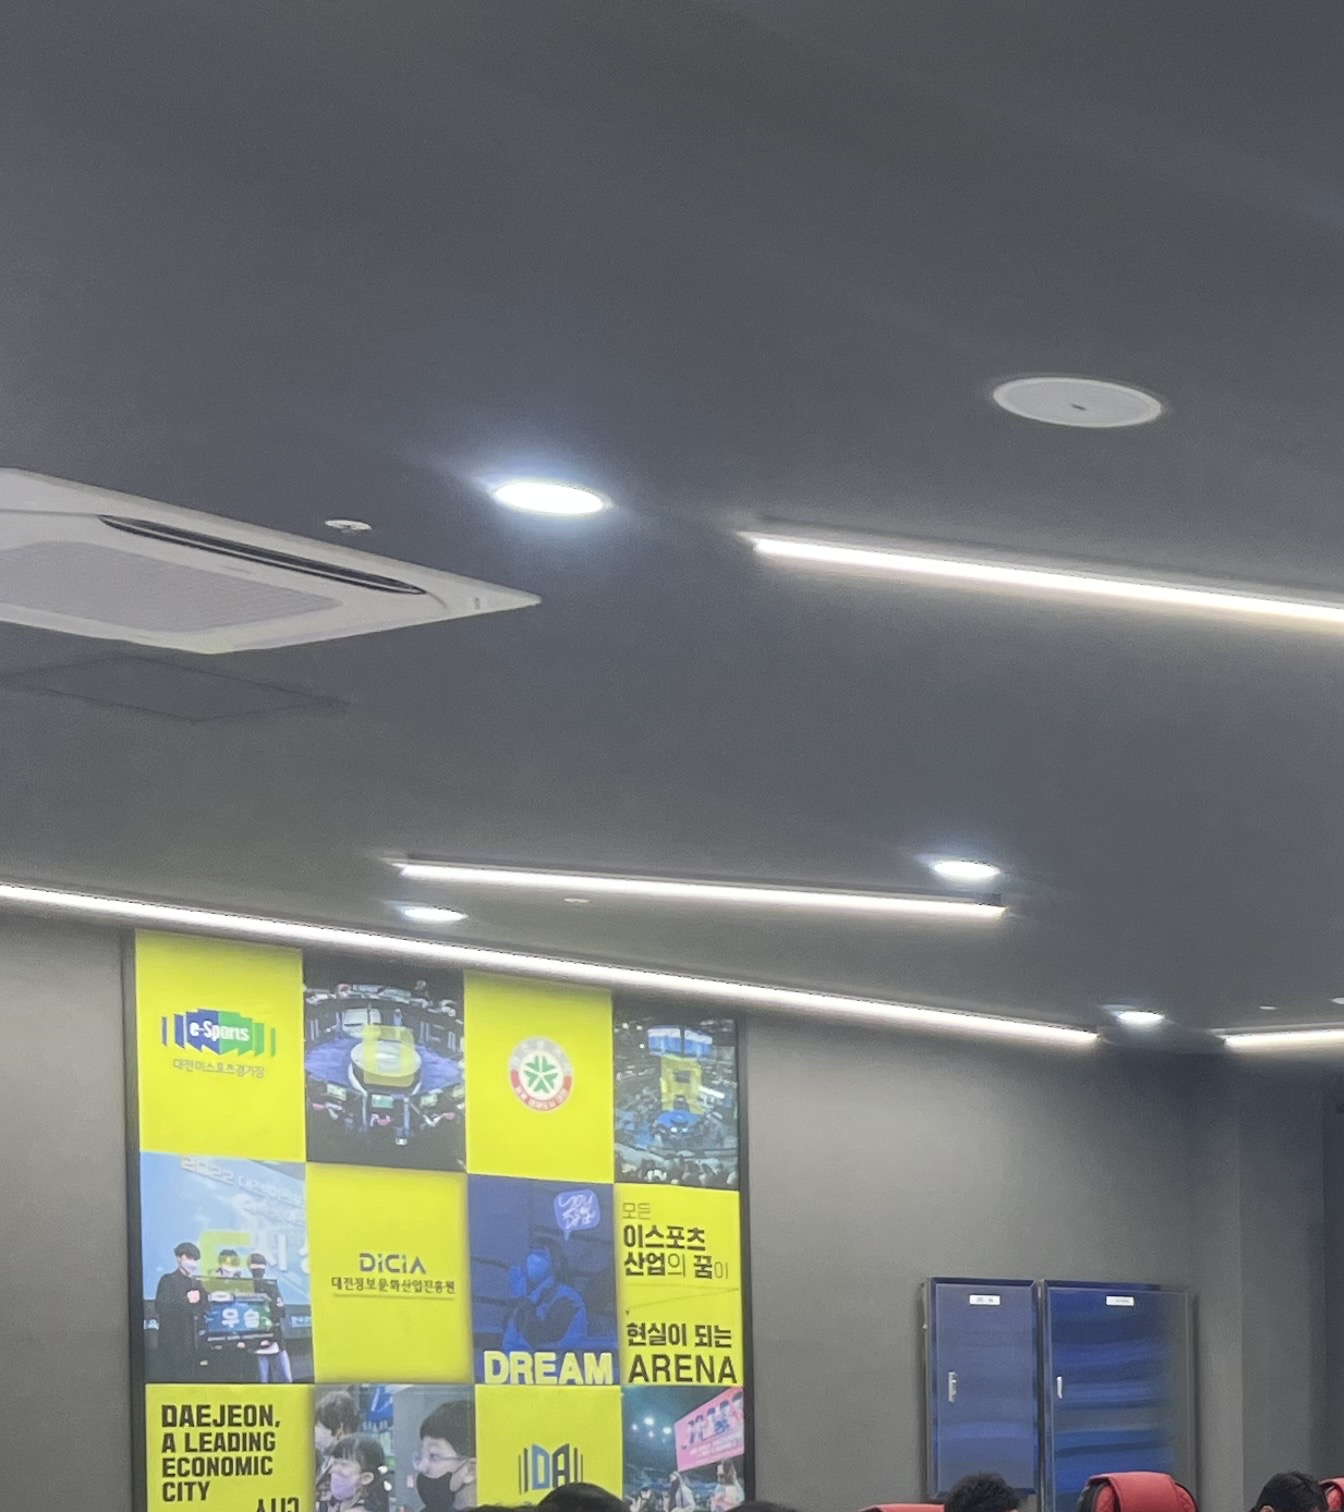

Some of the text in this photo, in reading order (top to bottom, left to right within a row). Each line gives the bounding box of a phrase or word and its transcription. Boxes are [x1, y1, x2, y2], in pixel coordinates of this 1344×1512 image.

[189, 1021, 250, 1042] e-Sports
[622, 1202, 651, 1220] 모든
[623, 1225, 706, 1251] 이스포츠
[624, 1252, 729, 1279] 산업의 꿈이
[331, 1277, 455, 1294] 대전정보문화산업진흥원
[626, 1323, 732, 1348] 현실이 되는
[484, 1351, 613, 1385] DREAM
[628, 1354, 738, 1384] ARENA
[161, 1404, 280, 1428] DAEJEON,
[161, 1432, 276, 1453] A LEADING
[162, 1456, 273, 1478] ECONOMIC
[162, 1480, 210, 1502] CITY
